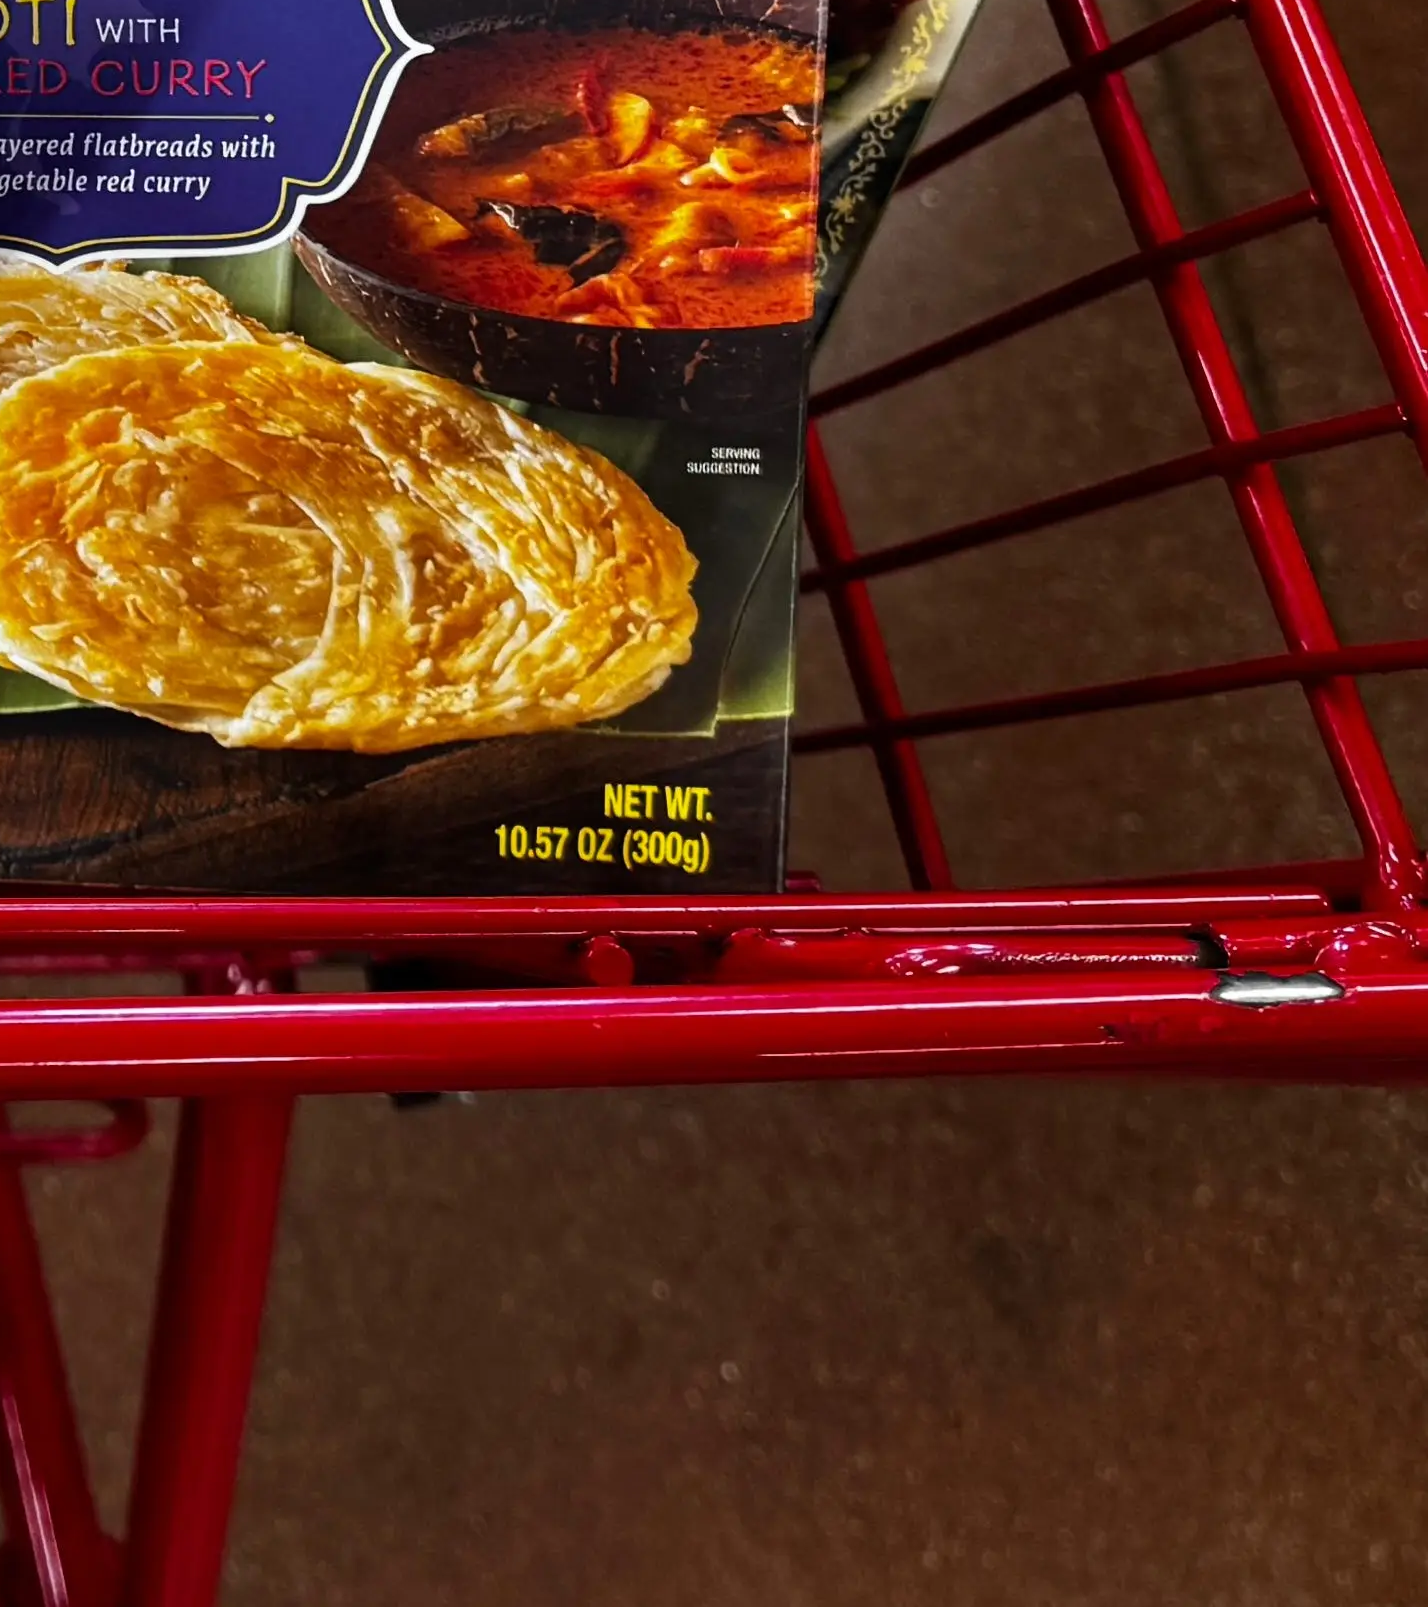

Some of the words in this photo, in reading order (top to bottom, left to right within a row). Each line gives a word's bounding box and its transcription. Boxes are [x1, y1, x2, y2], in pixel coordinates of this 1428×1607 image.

[96, 17, 180, 44] WITH
[90, 58, 268, 99] CURRY
[82, 133, 214, 160] flatbreads
[221, 134, 276, 159] with
[95, 170, 135, 193] red
[142, 175, 211, 201] curry
[686, 461, 760, 475] SUGGESTION
[711, 447, 760, 460] SERVING
[604, 783, 658, 819] NET
[665, 785, 714, 822] WT.
[495, 824, 569, 860] 10.57
[577, 826, 614, 862] OZ
[622, 828, 710, 874] (300g)
